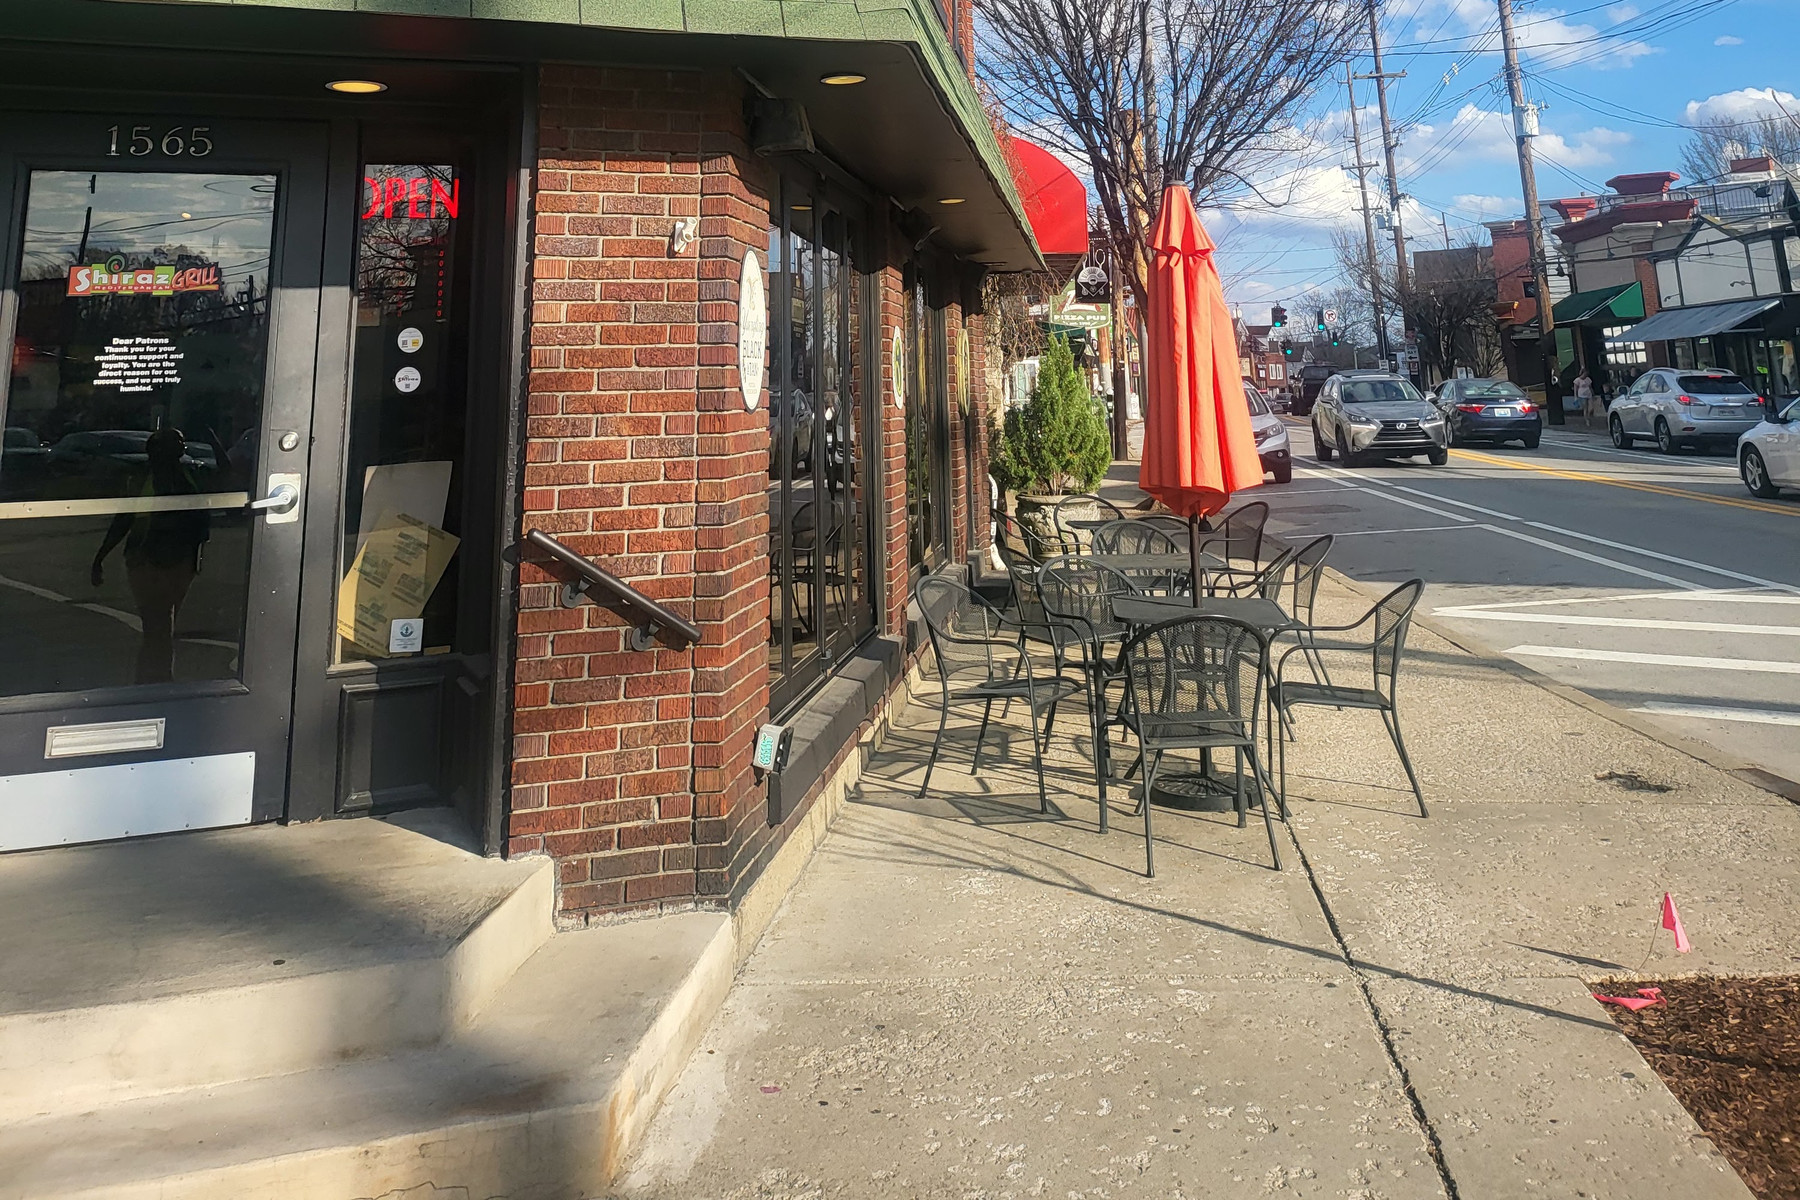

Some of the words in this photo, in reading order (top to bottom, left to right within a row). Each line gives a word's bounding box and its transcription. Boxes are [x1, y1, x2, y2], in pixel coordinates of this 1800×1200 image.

[106, 125, 213, 156] 1565
[75, 268, 169, 292] Shiraz
[171, 266, 219, 289] GRILL
[112, 337, 134, 345] Dear
[743, 339, 762, 359] BLACK
[101, 362, 130, 370] loyalty.
[164, 376, 181, 384] truly
